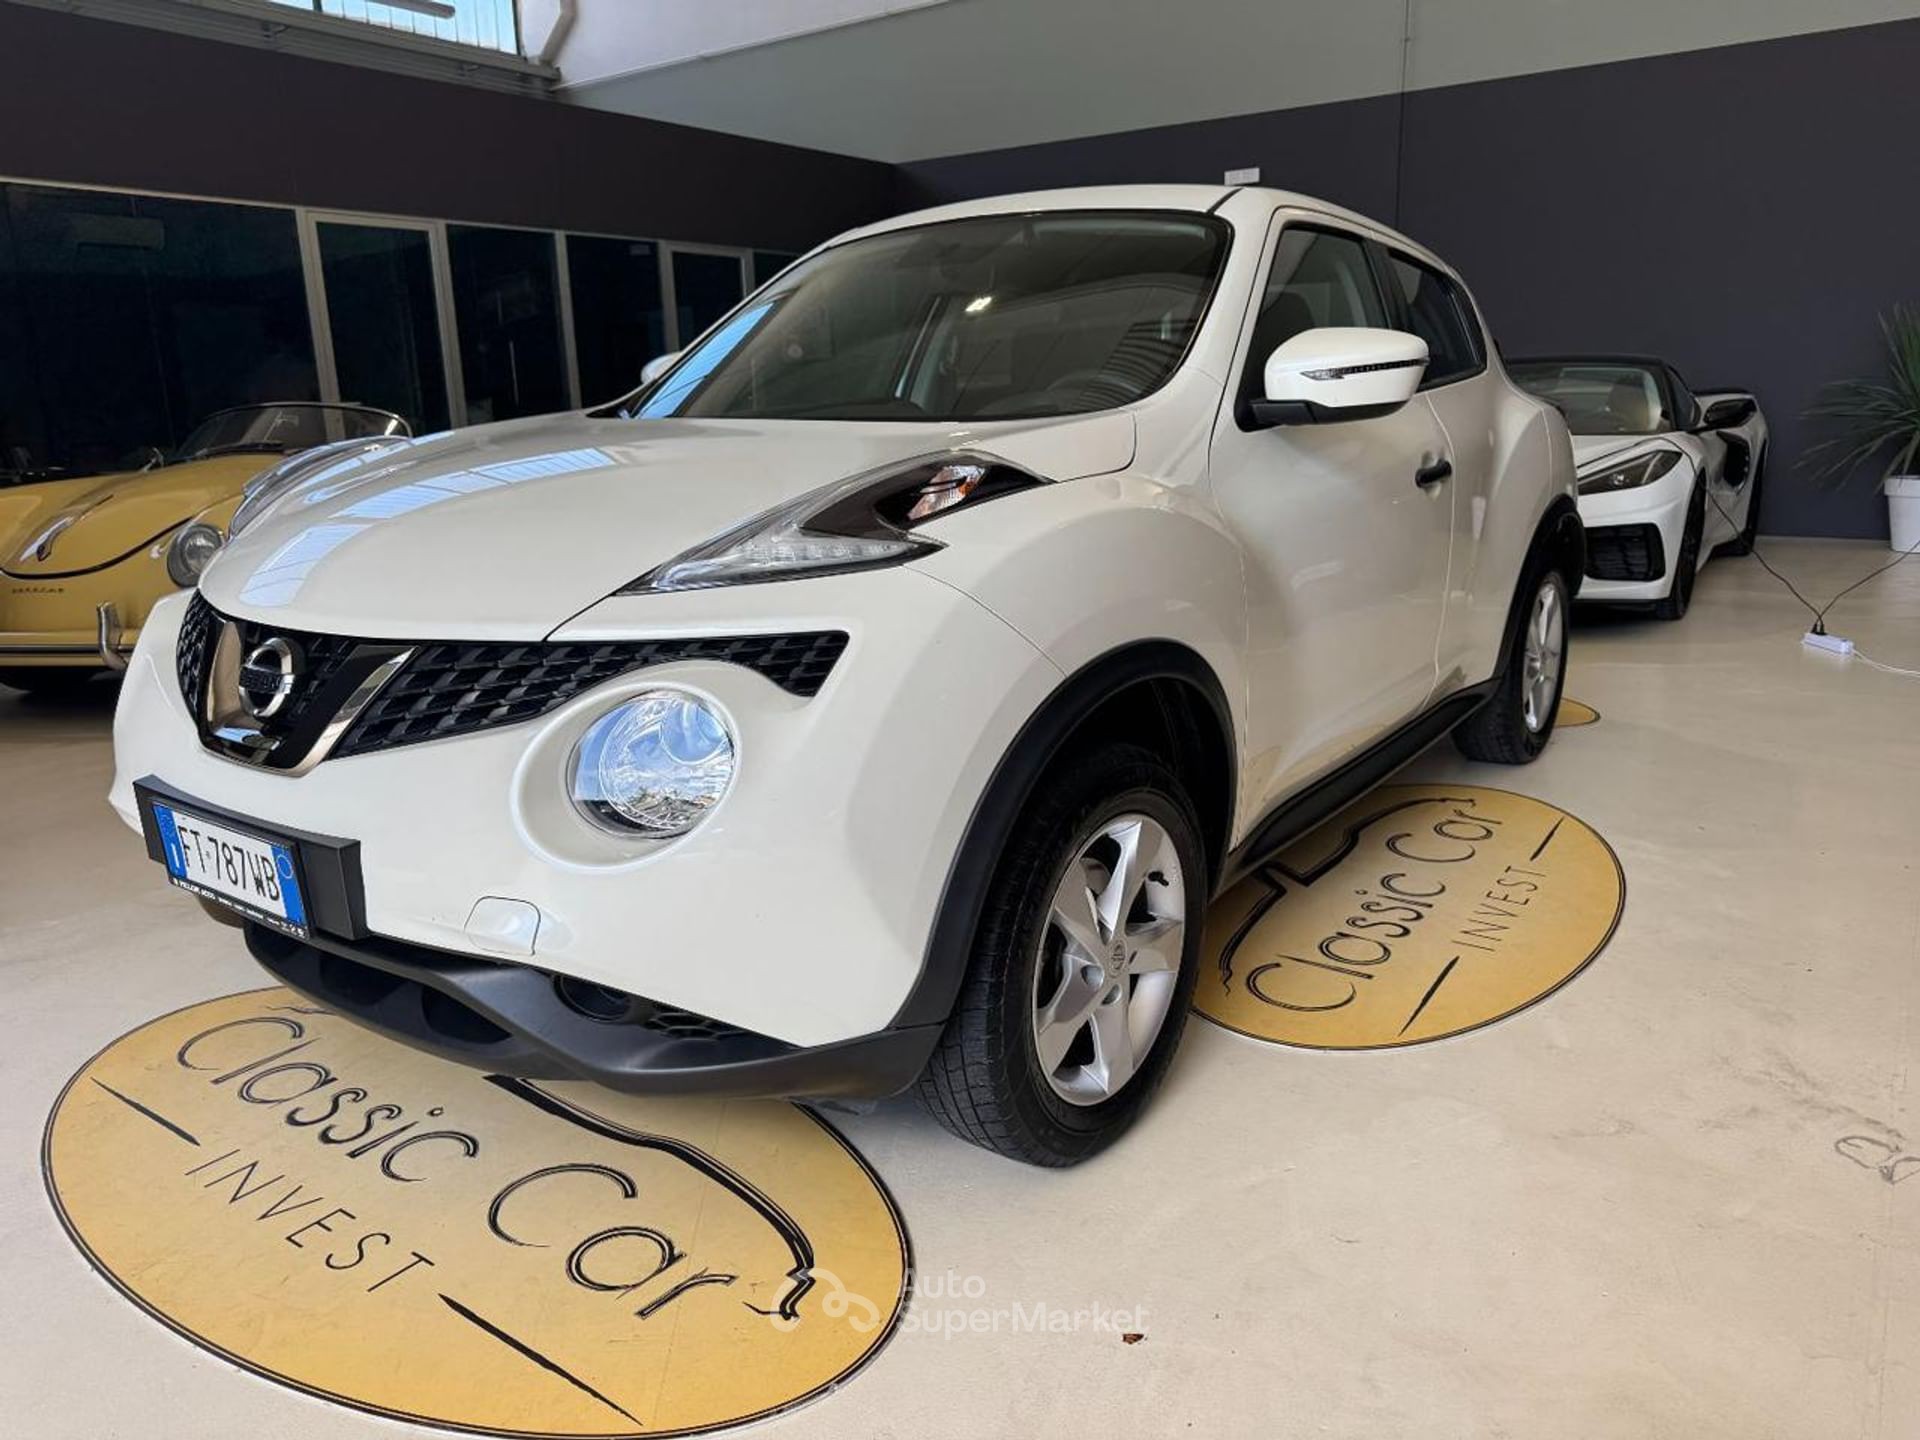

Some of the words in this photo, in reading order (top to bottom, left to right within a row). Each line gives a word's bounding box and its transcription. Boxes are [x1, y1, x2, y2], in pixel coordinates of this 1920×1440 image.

[1245, 873, 1447, 1012] Classic
[1386, 807, 1502, 863] Car
[1451, 864, 1547, 952] INVEST
[177, 1016, 480, 1182] Classic
[487, 1162, 739, 1320] Car
[184, 1148, 435, 1293] INVEST
